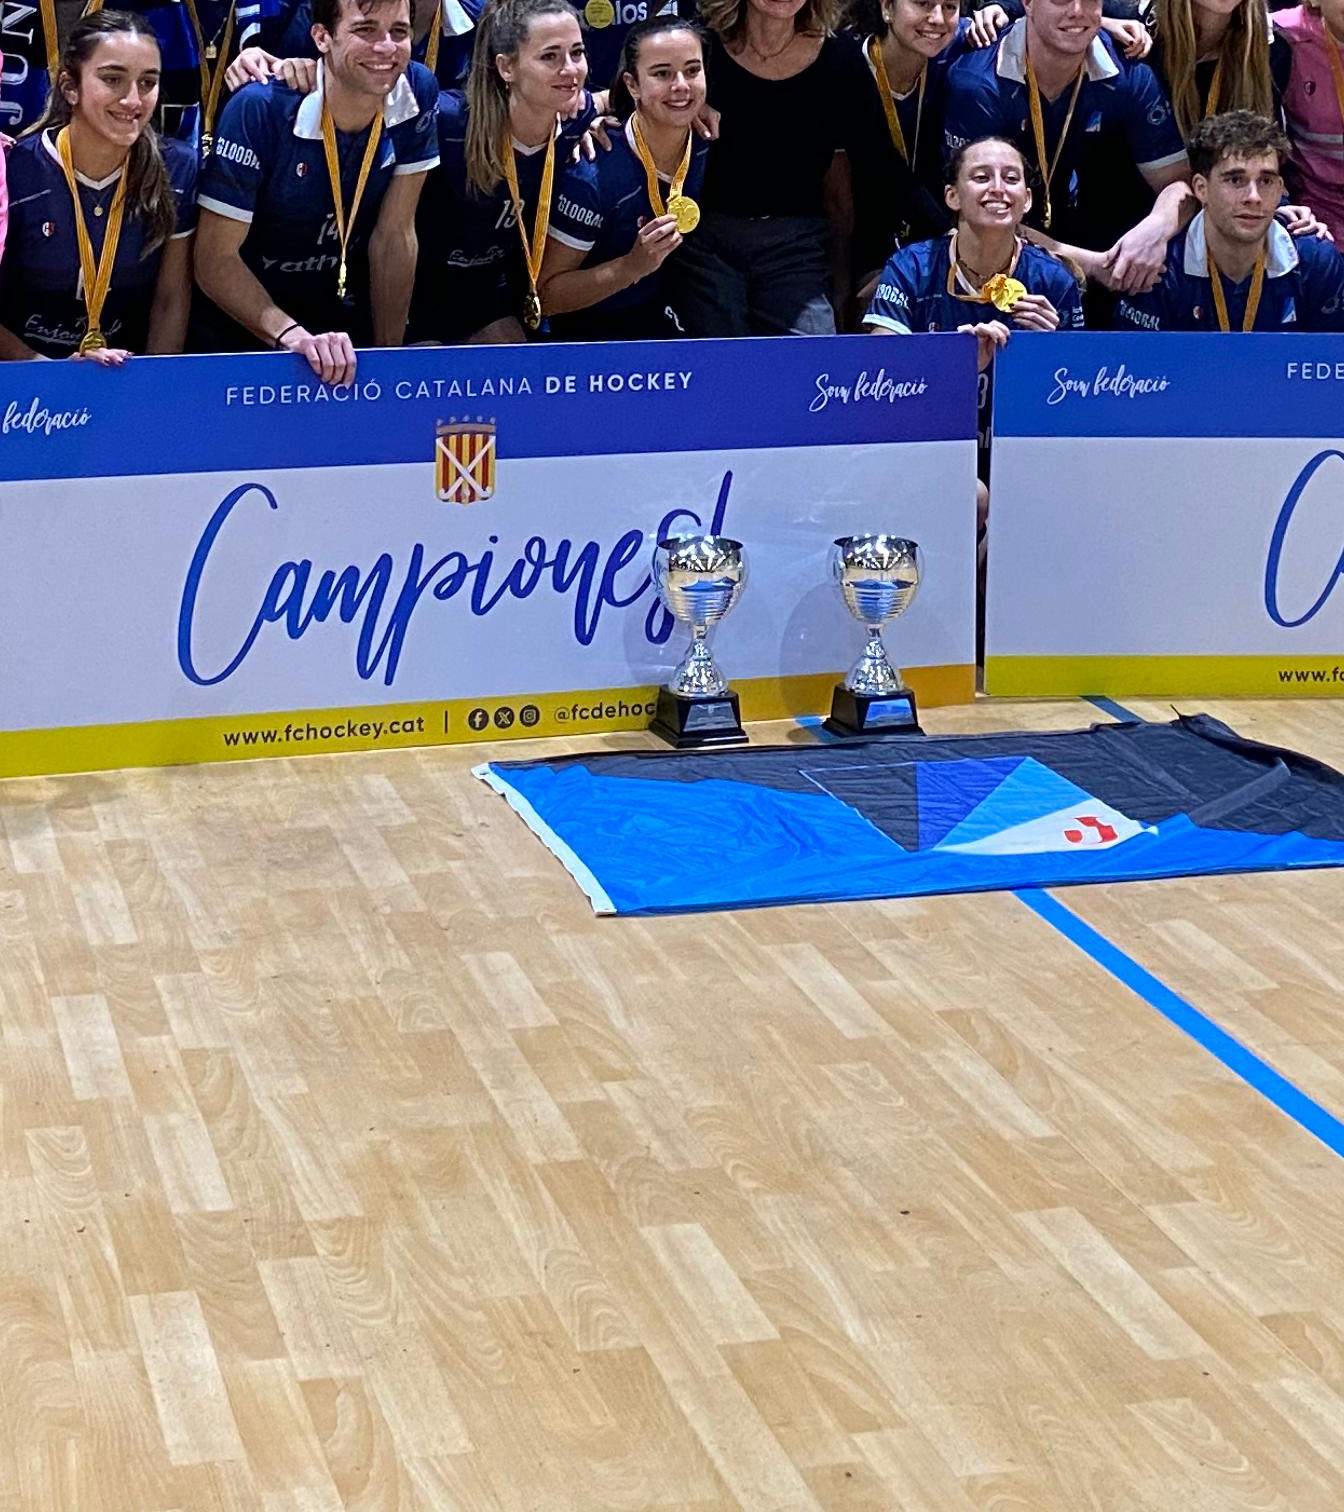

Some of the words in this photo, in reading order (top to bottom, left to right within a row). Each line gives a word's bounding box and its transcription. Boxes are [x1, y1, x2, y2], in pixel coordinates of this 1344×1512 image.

[227, 382, 381, 405] FEDERACIÓ
[395, 377, 532, 399] CATALANA
[546, 376, 576, 394] DE
[589, 372, 692, 392] HOCKEY
[809, 373, 851, 412] Som
[853, 368, 928, 403] federació
[1047, 367, 1090, 405] Som
[1093, 364, 1170, 399] federació
[2, 396, 92, 436] federació
[223, 716, 425, 746] www.fchockey.cat
[555, 700, 656, 724] @fcdehoc
